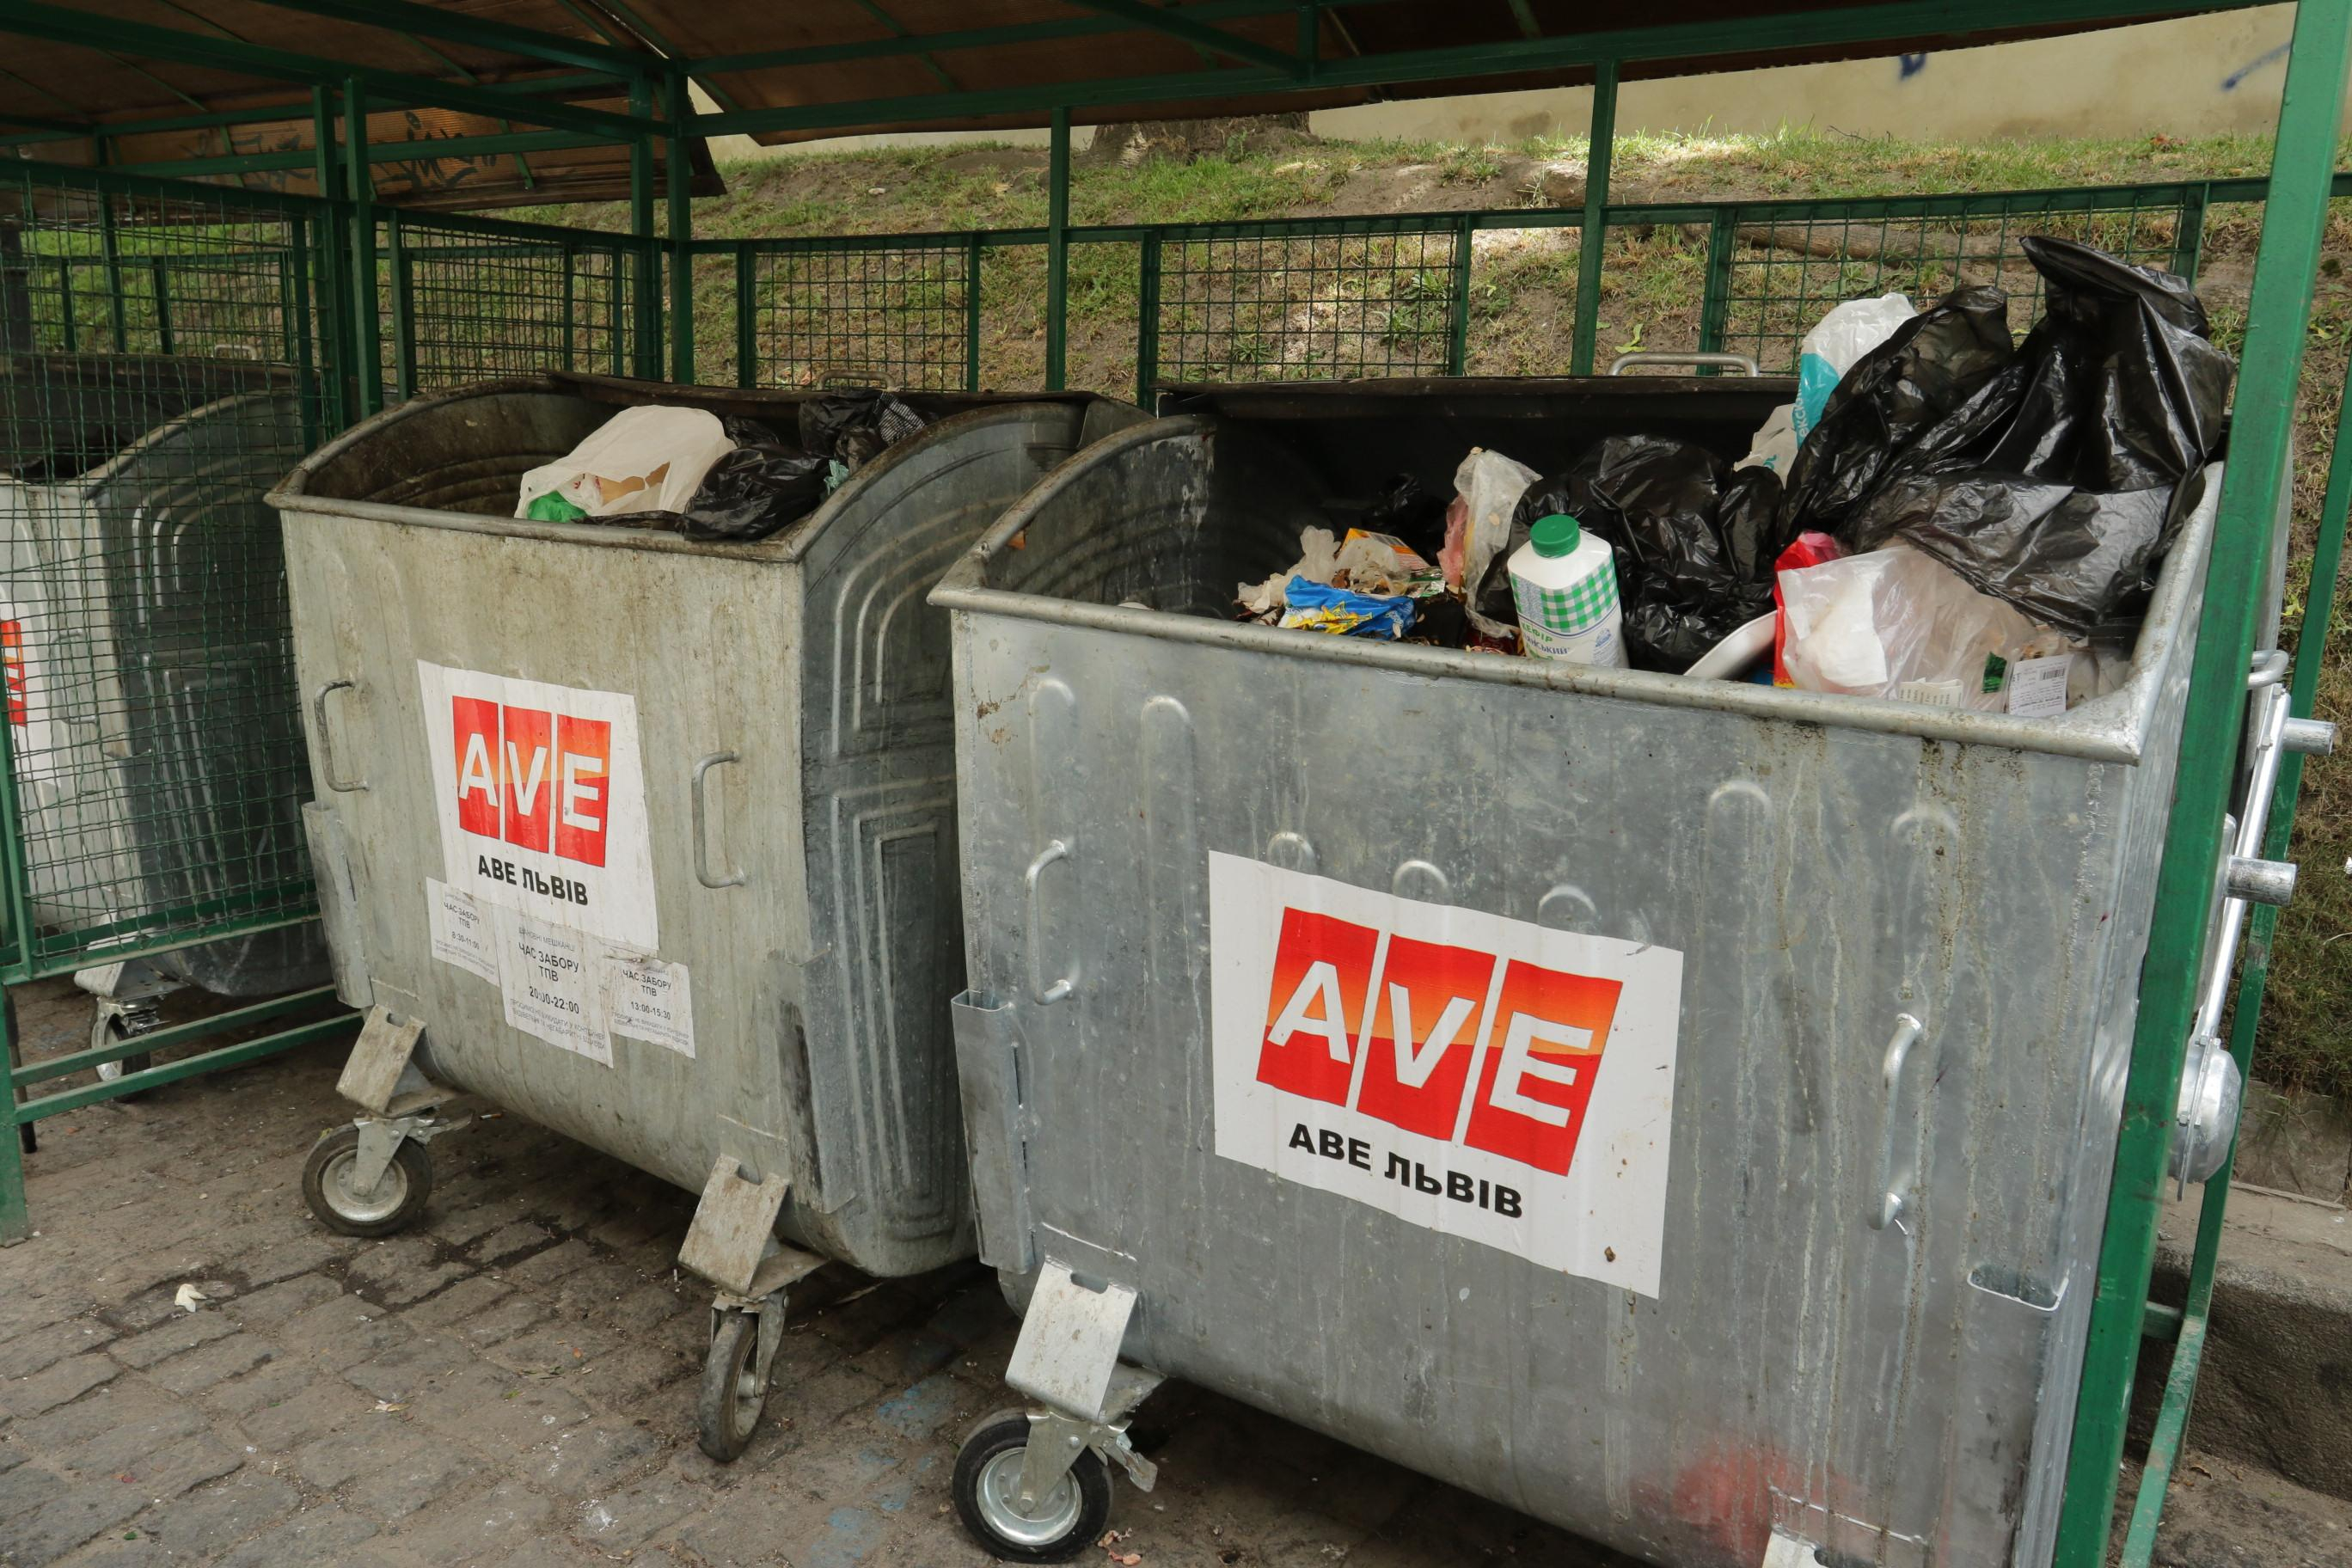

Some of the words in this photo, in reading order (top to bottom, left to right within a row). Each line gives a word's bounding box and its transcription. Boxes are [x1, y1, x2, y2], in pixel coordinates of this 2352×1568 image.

[458, 733, 603, 832] AVE
[478, 854, 518, 885] АВЕ
[522, 867, 588, 906] ЛЬВІВ
[518, 942, 536, 959] ЧАС
[538, 951, 579, 972] ЗАБОРУ
[538, 965, 559, 982] ТПВ
[622, 970, 639, 981] ЧАС
[641, 975, 671, 990] ЗАБОРУ
[530, 985, 579, 1014] 20:00-22:00
[640, 985, 657, 997] ТПВ
[631, 1001, 671, 1020] 13:00-15:30
[1267, 960, 1593, 1128] AVE
[1289, 1123, 1371, 1171] АВЕ
[1384, 1151, 1522, 1218] ЛЬВІВ
